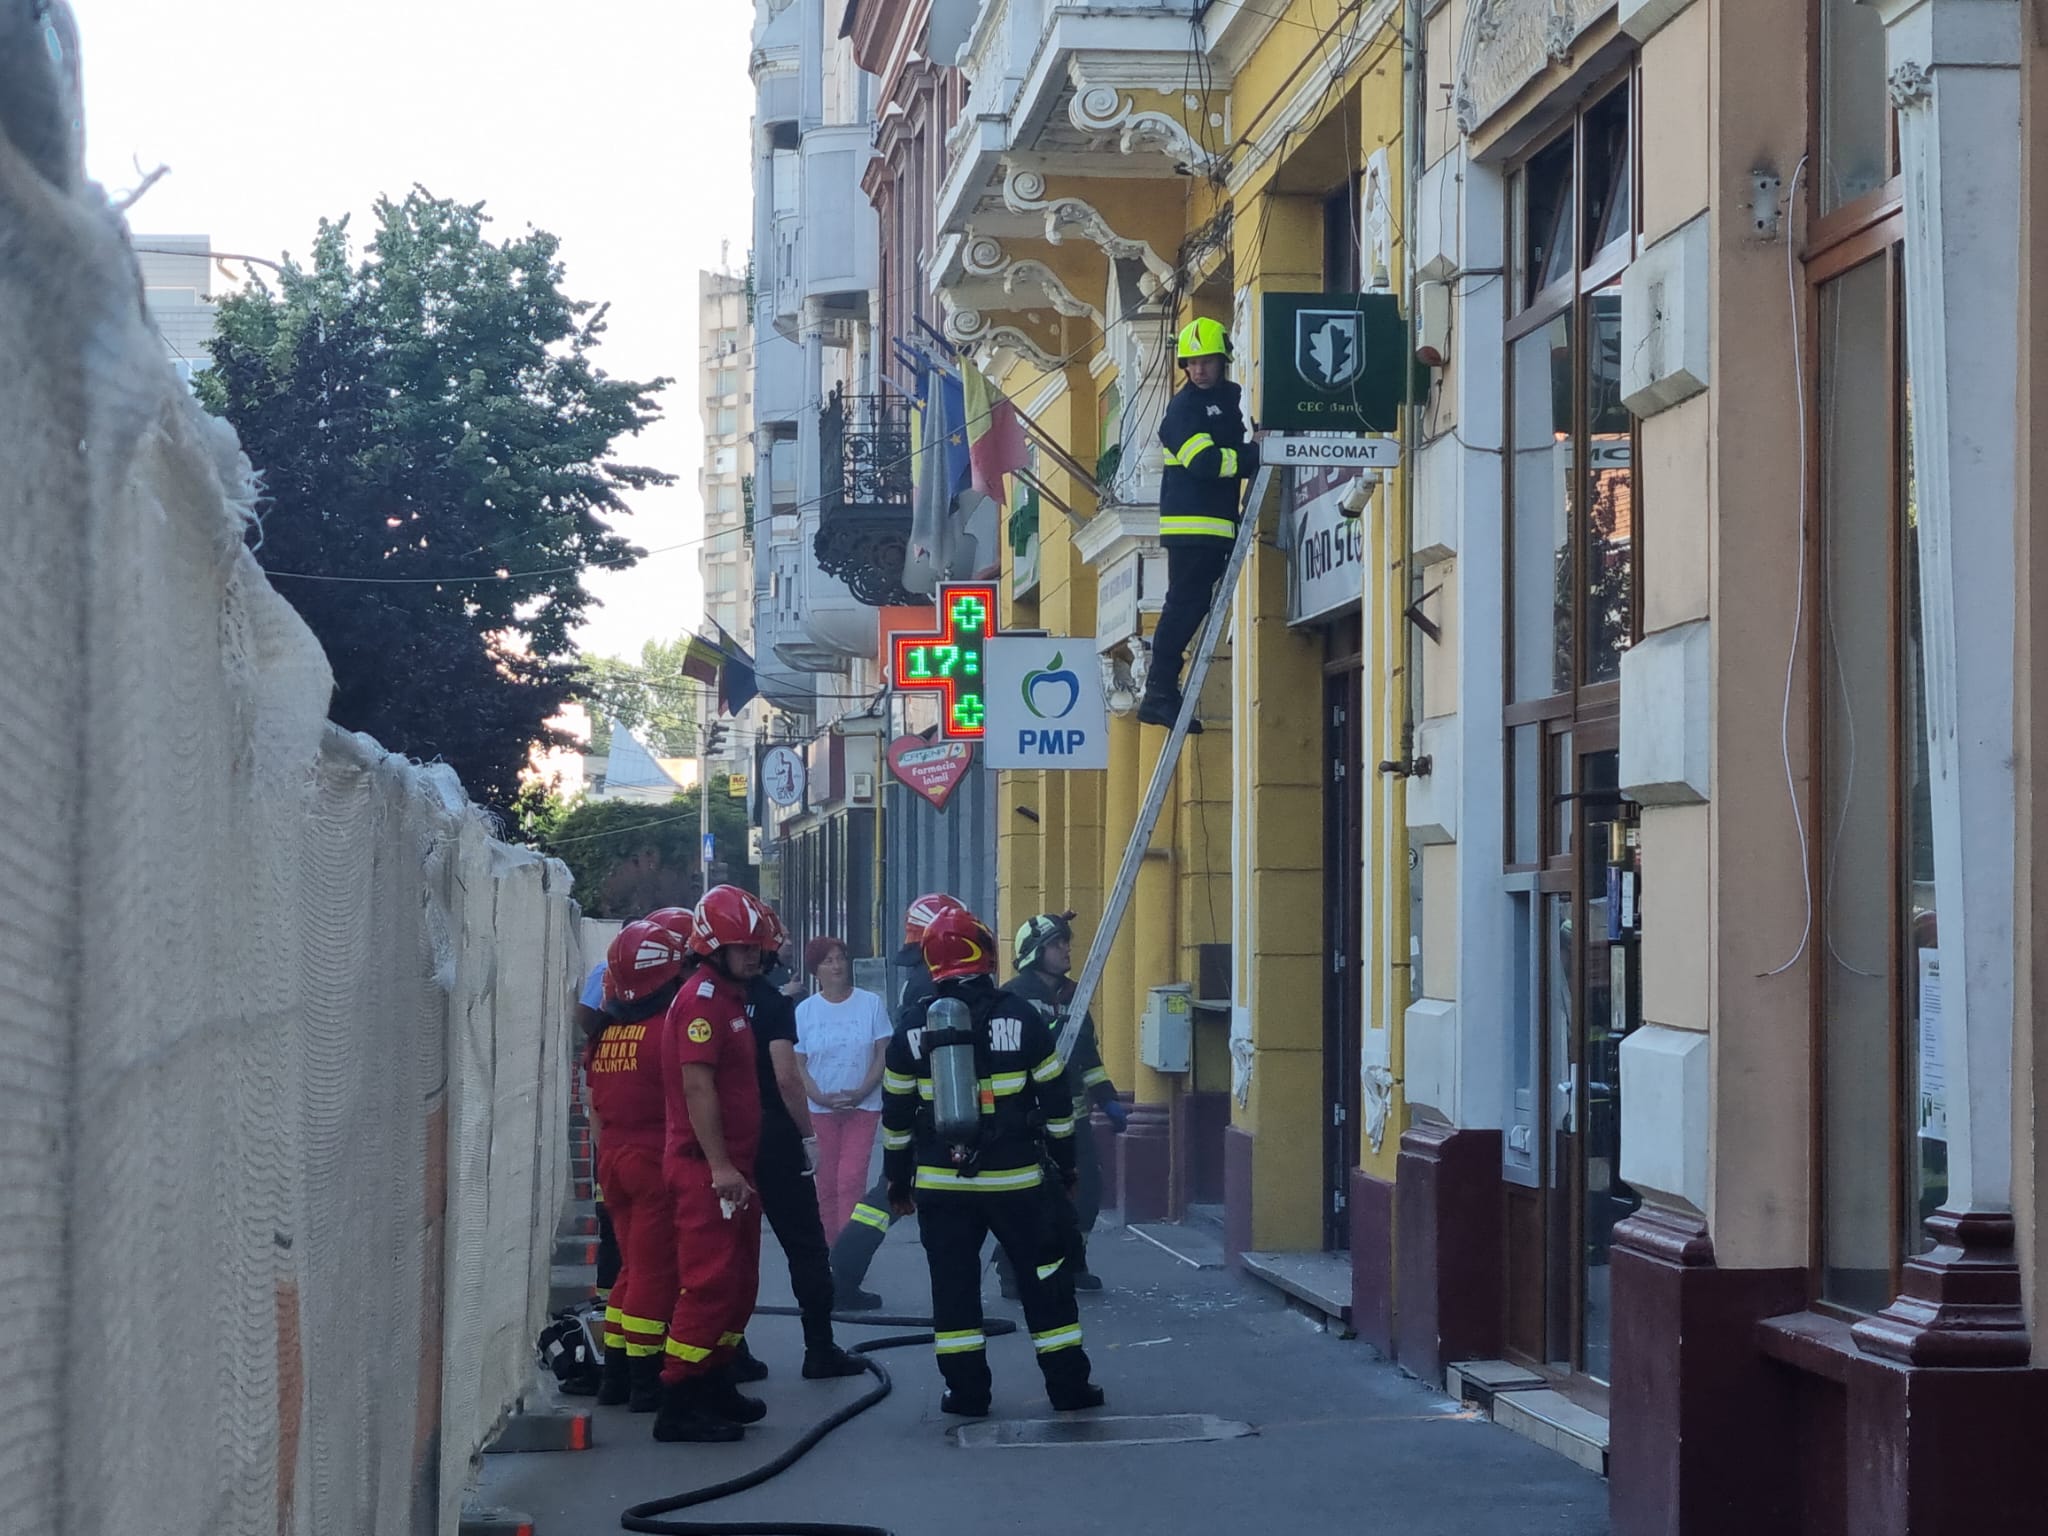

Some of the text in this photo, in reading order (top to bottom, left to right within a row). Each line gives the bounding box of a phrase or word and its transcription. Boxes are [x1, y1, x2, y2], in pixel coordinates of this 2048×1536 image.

[1297, 401, 1324, 412] CEC
[1286, 444, 1378, 459] BANCOMAT
[1018, 729, 1085, 754] PMP
